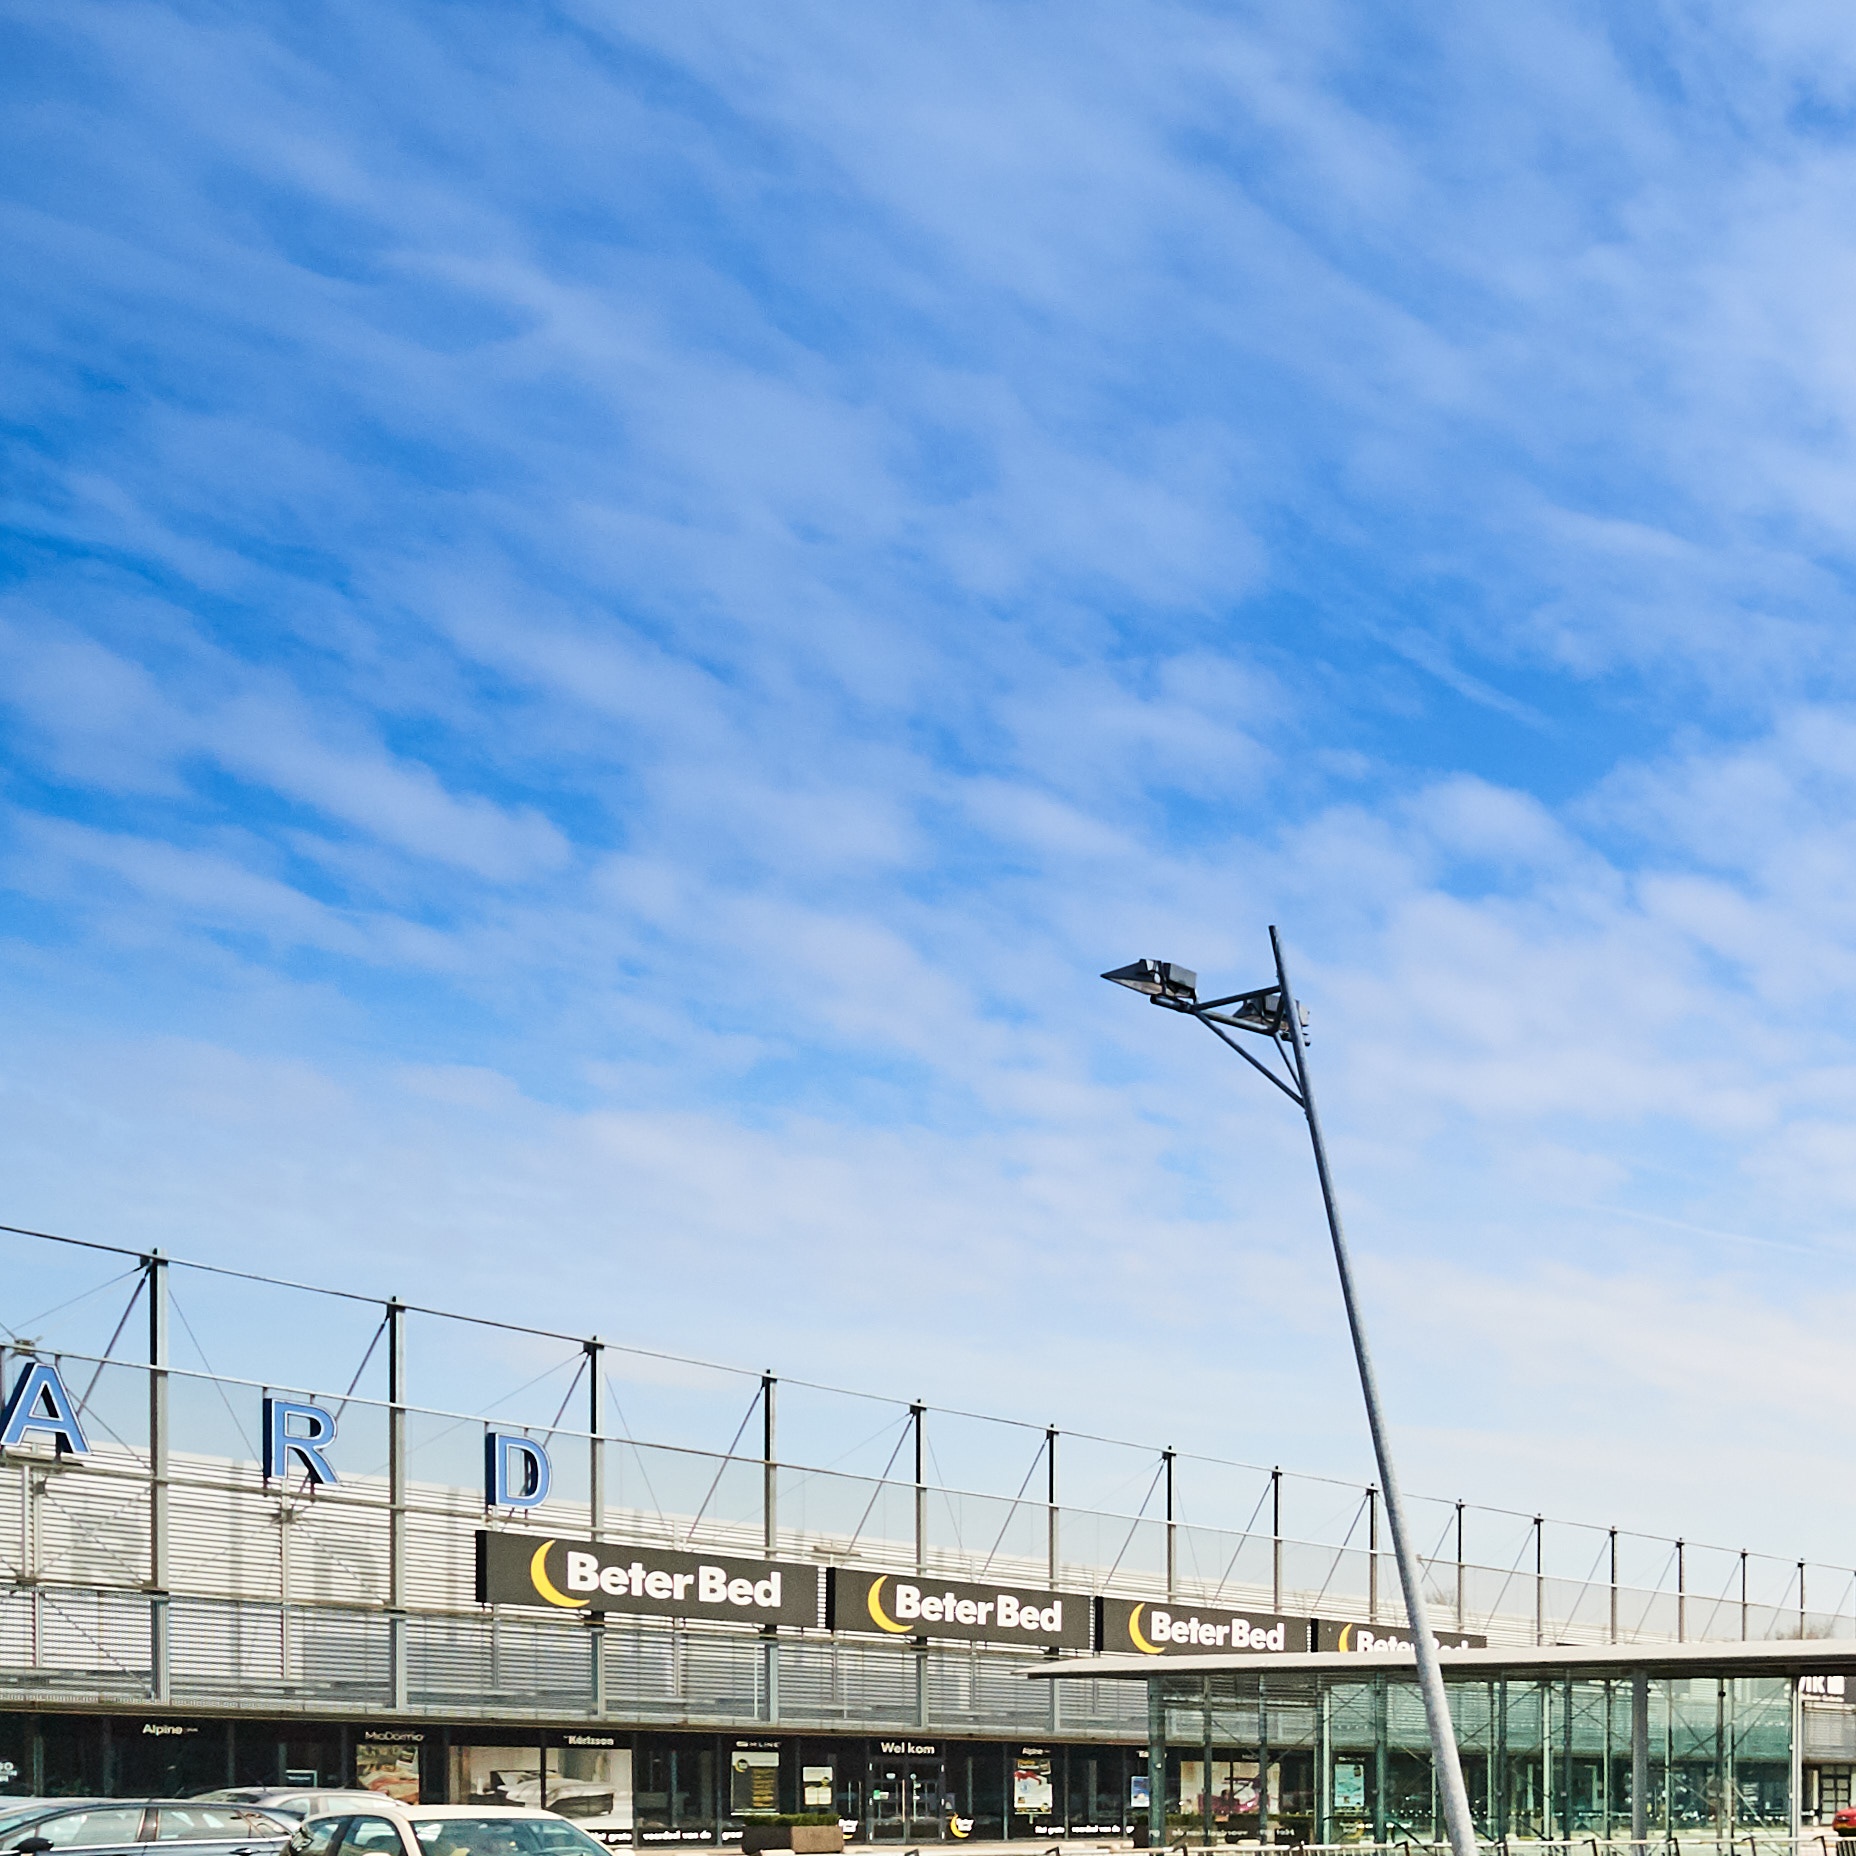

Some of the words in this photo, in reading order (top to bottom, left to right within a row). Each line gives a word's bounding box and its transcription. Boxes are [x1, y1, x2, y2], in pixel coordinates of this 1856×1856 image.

[567, 1551, 694, 1600] Beter
[698, 1565, 781, 1607] Bed
[895, 1584, 994, 1625] Beter
[997, 1594, 1062, 1632] Bed
[1151, 1611, 1229, 1646] Beter
[1231, 1618, 1285, 1651] Bed
